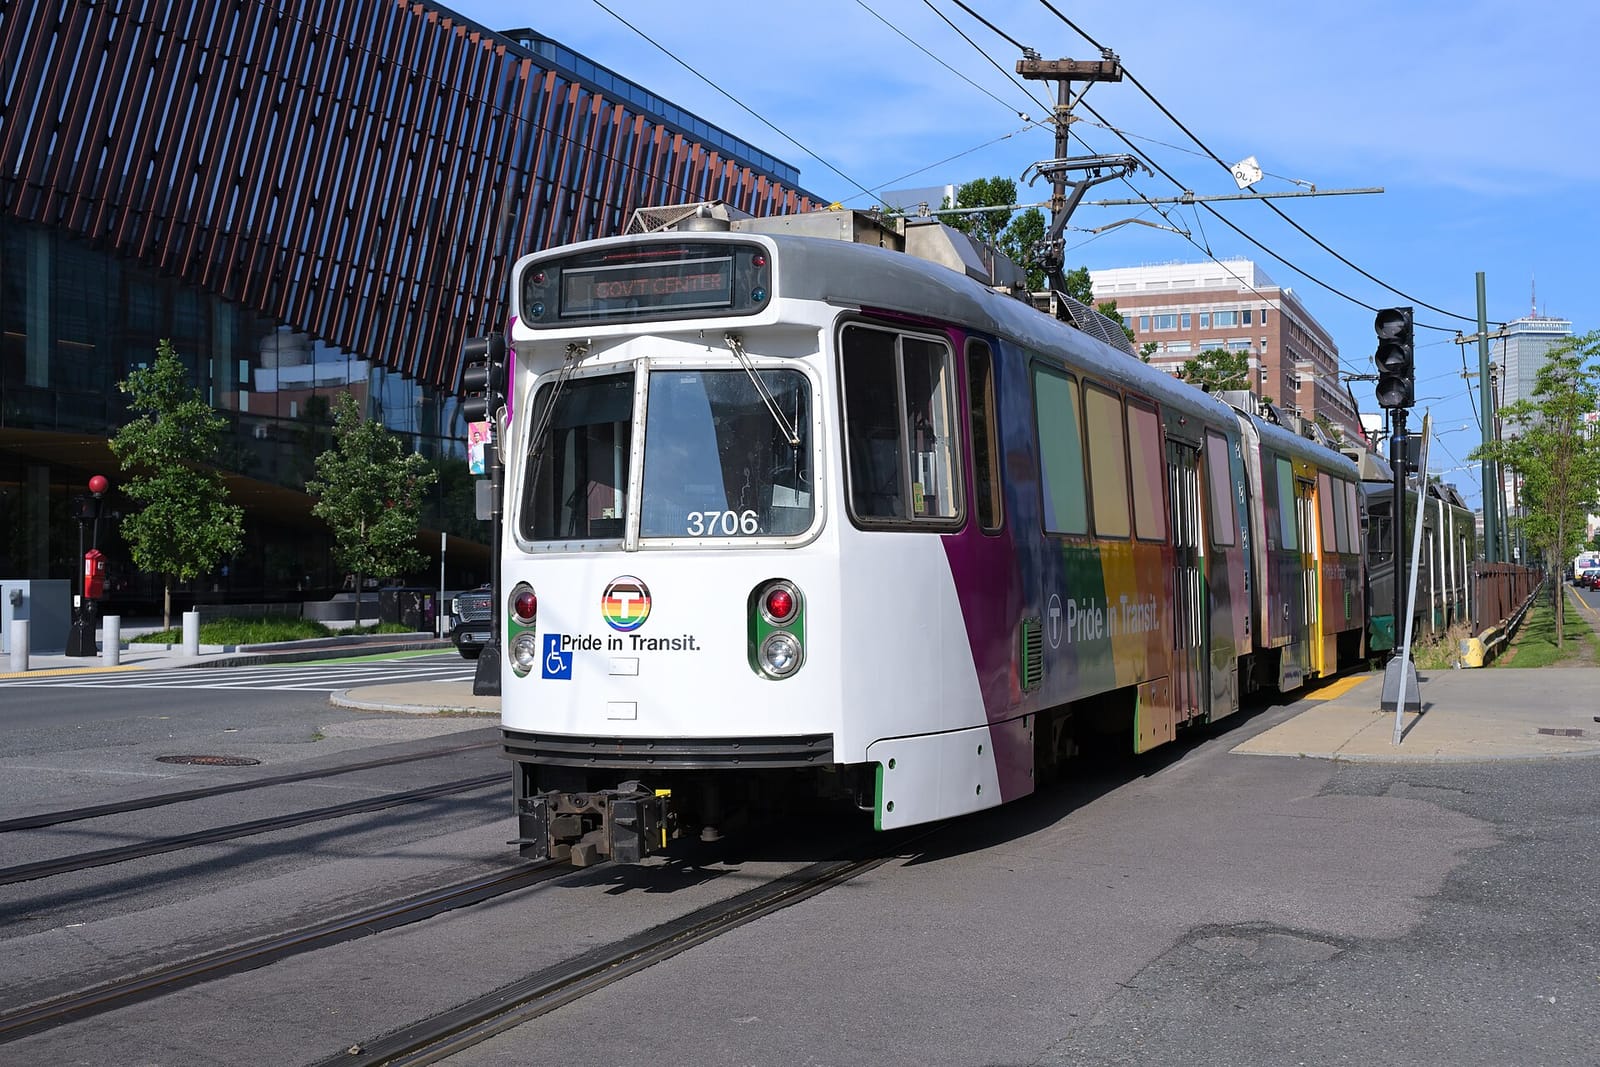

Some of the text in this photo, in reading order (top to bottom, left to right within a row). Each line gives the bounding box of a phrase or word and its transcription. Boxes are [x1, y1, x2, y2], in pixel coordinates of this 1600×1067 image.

[597, 273, 721, 298] GOV'T CENTER
[686, 510, 759, 536] 3706
[611, 591, 640, 619] T
[1067, 593, 1160, 644] Pride in Transit.
[561, 634, 701, 651] Pride in Transit.
